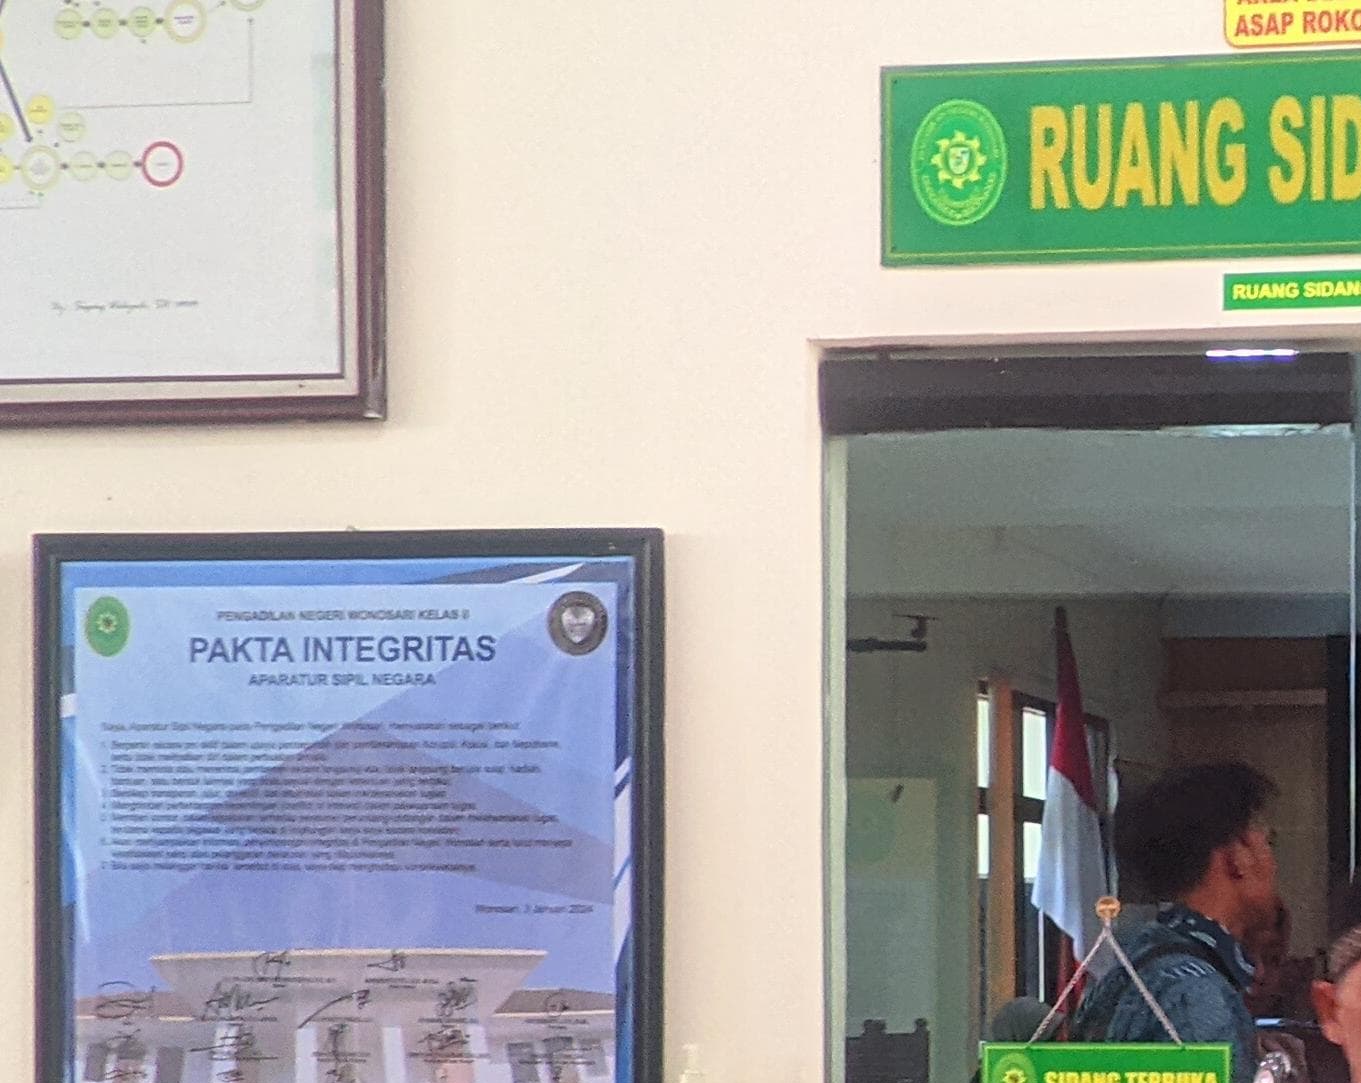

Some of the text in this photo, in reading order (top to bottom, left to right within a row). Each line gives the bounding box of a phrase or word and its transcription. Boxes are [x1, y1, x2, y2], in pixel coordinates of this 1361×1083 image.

[1234, 12, 1293, 37] ASAP
[1029, 96, 1248, 211] RUANG
[1232, 282, 1300, 300] RUANG
[299, 609, 345, 621] NEGERI
[417, 609, 461, 620] KELAS
[189, 634, 497, 663] PAKTA INTEGRITAS
[248, 673, 436, 687] APARATUR SIPIL NEGARA
